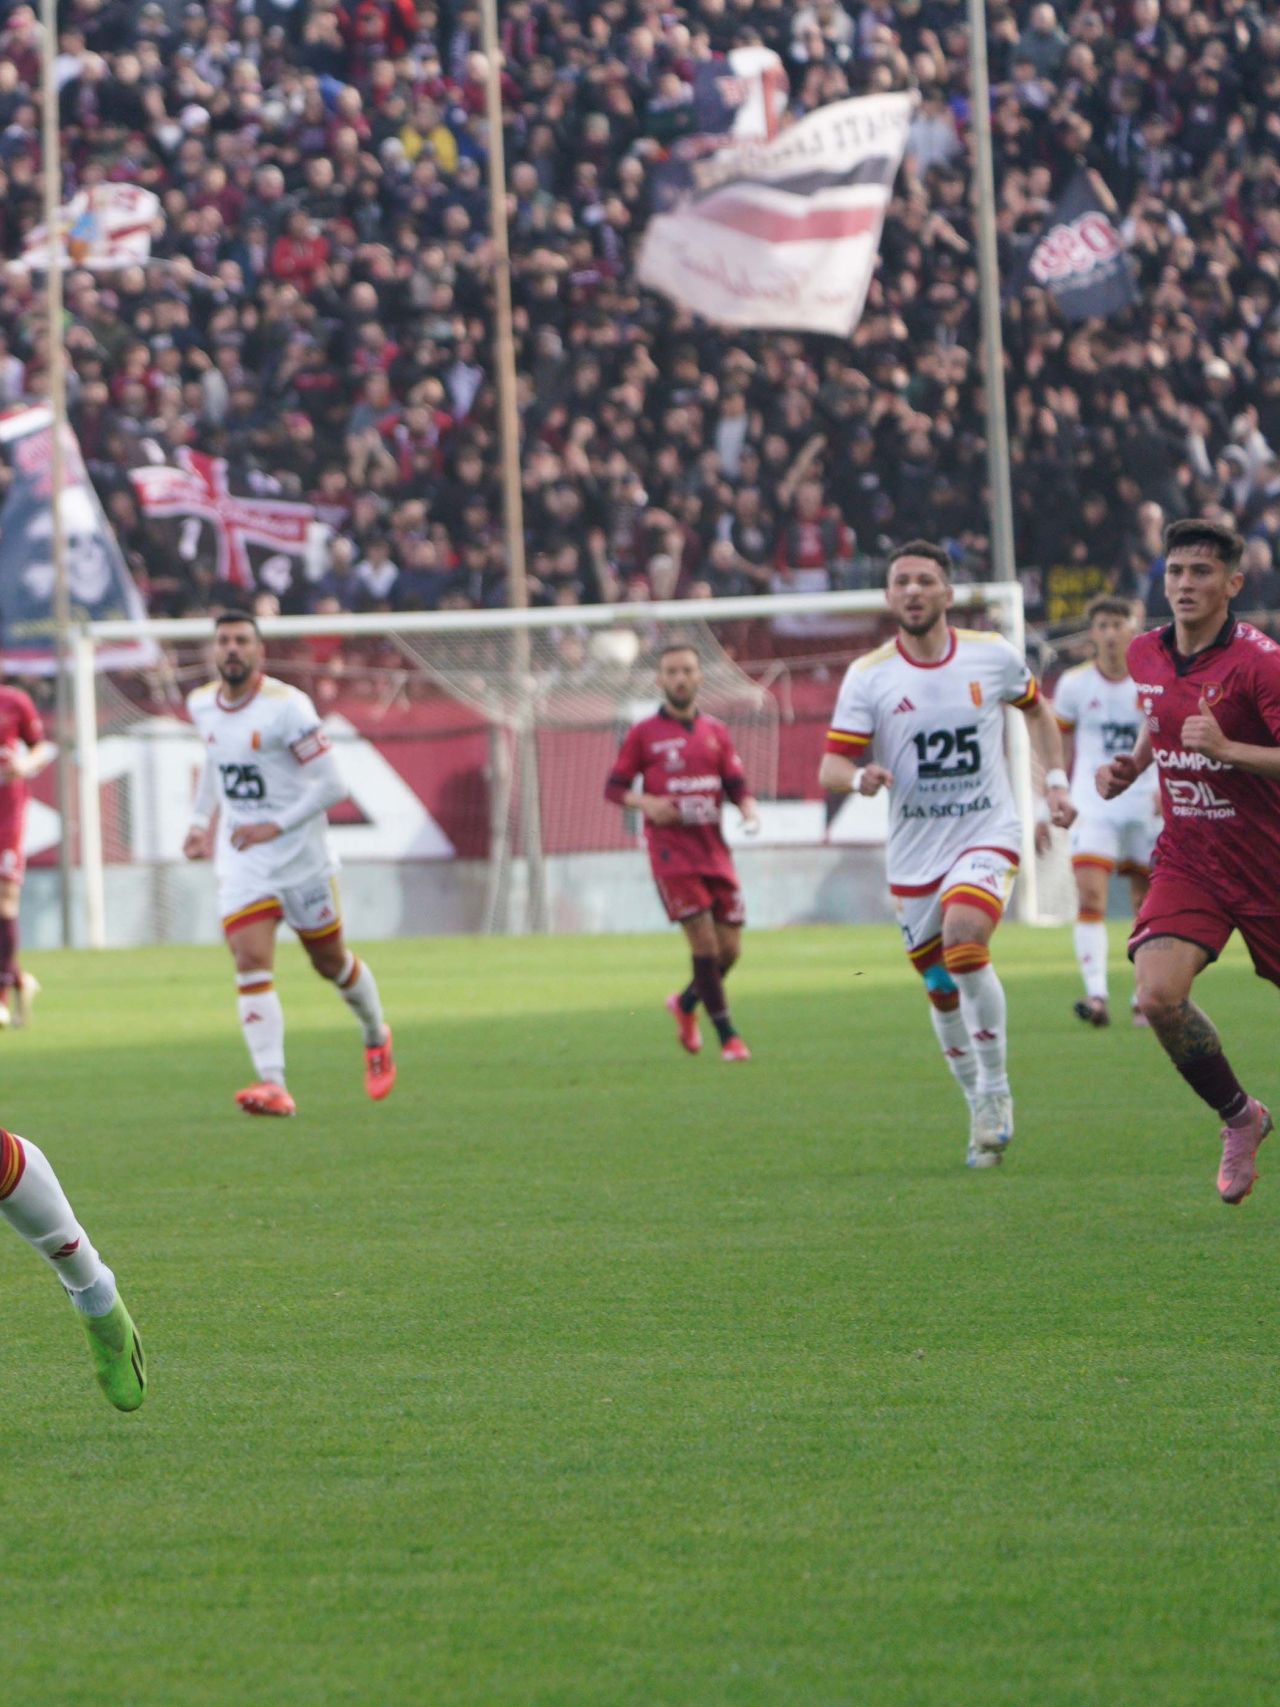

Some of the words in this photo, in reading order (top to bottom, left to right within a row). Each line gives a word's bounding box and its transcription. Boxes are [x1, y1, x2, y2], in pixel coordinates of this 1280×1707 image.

[912, 725, 982, 779] 125
[219, 764, 266, 800] 125
[1164, 778, 1231, 806] EDIL
